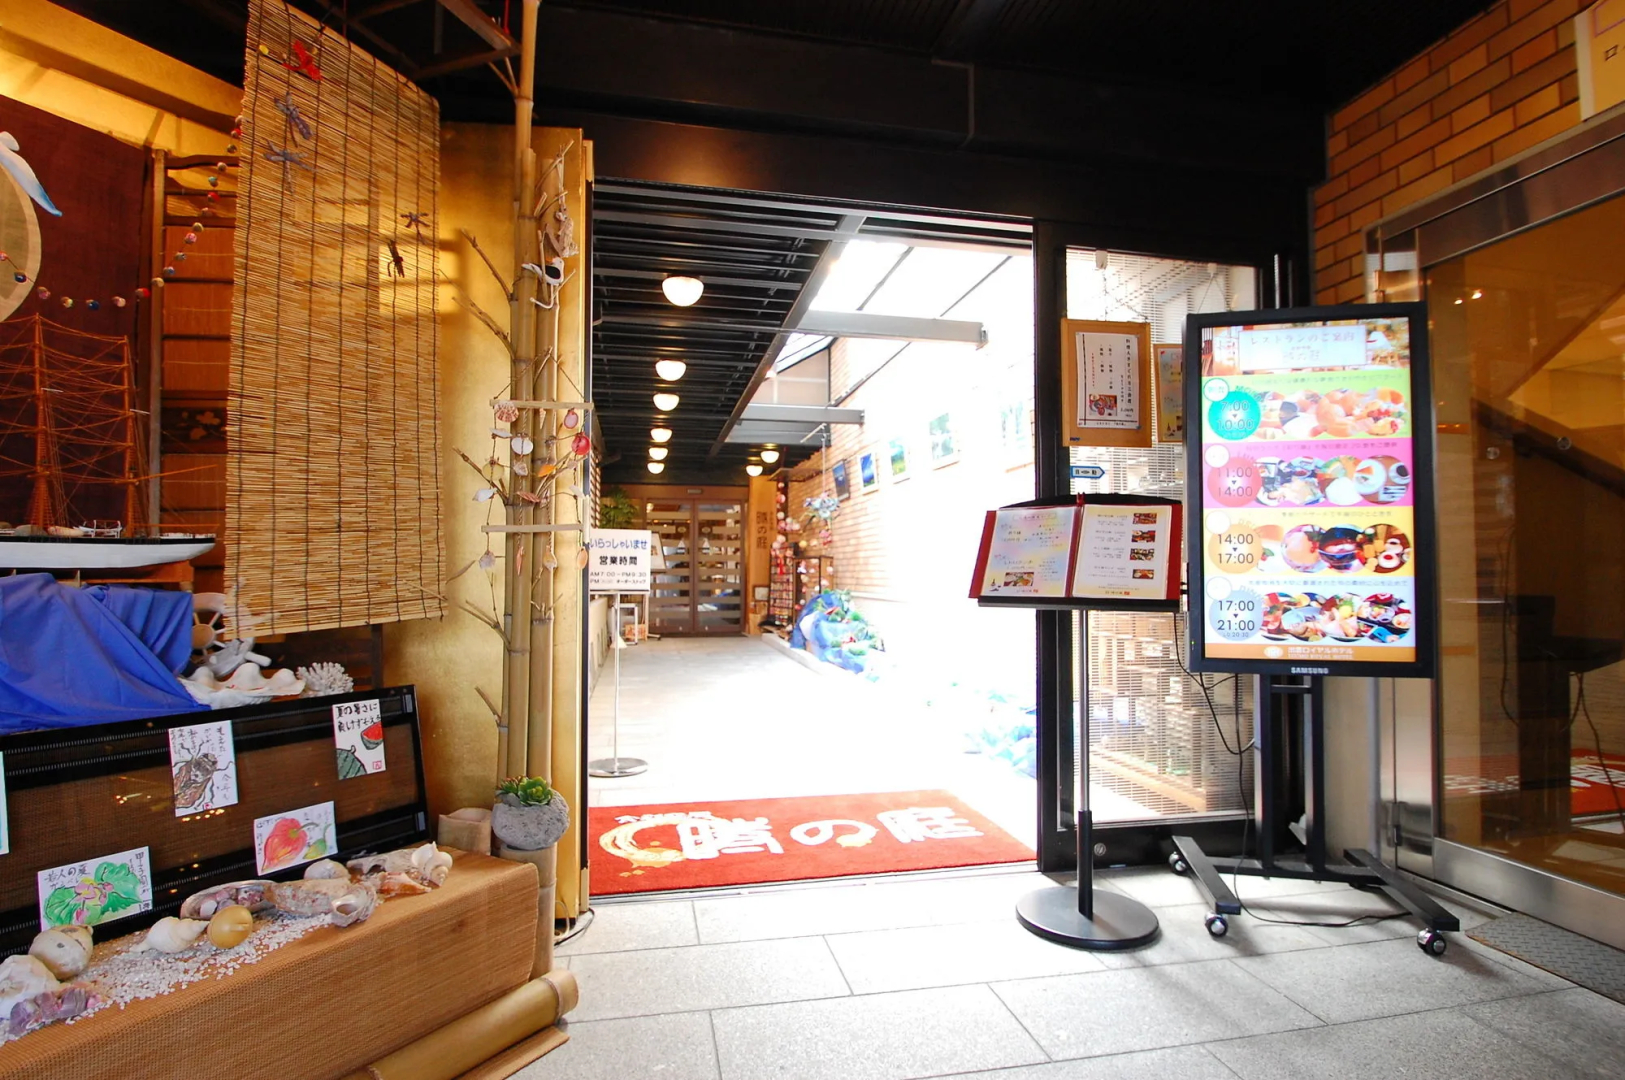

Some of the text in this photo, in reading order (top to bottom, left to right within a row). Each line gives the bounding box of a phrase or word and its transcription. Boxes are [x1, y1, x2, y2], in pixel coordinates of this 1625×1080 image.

[1221, 400, 1250, 411] 7:00
[1216, 418, 1255, 430] 10:00
[1217, 467, 1253, 478] 11:00
[1217, 486, 1253, 497] 14:00
[589, 538, 648, 550] いらっしゃいませ
[1217, 533, 1254, 545] 14:00
[599, 555, 638, 566] 営業時間
[1217, 553, 1255, 564] 17:00
[1218, 600, 1255, 611] 17:00
[1217, 619, 1255, 631] 21:00
[1290, 666, 1329, 674] SAMSUNG
